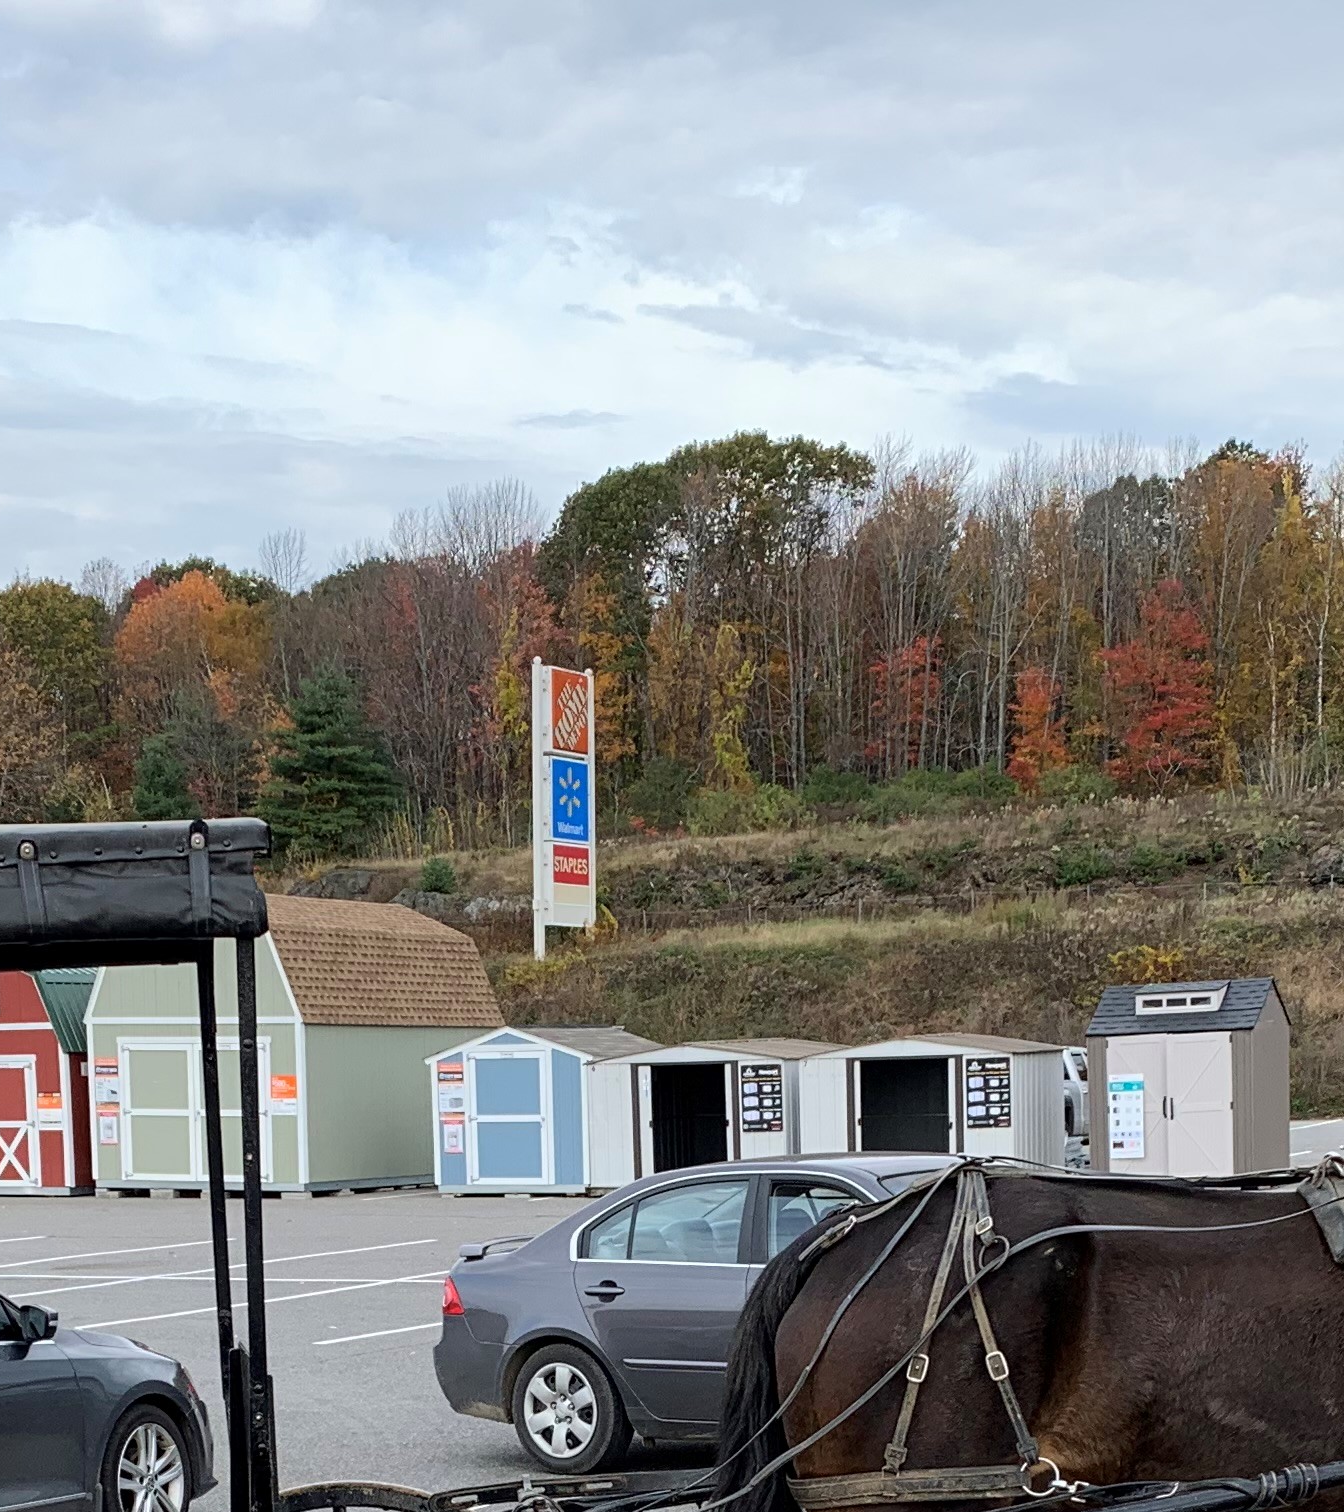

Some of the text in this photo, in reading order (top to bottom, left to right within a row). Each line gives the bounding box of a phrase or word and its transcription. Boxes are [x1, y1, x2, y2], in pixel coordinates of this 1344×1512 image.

[557, 678, 574, 711] THE
[554, 677, 588, 749] HOME
[557, 821, 584, 837] Walmart
[554, 856, 588, 875] STAPLES
